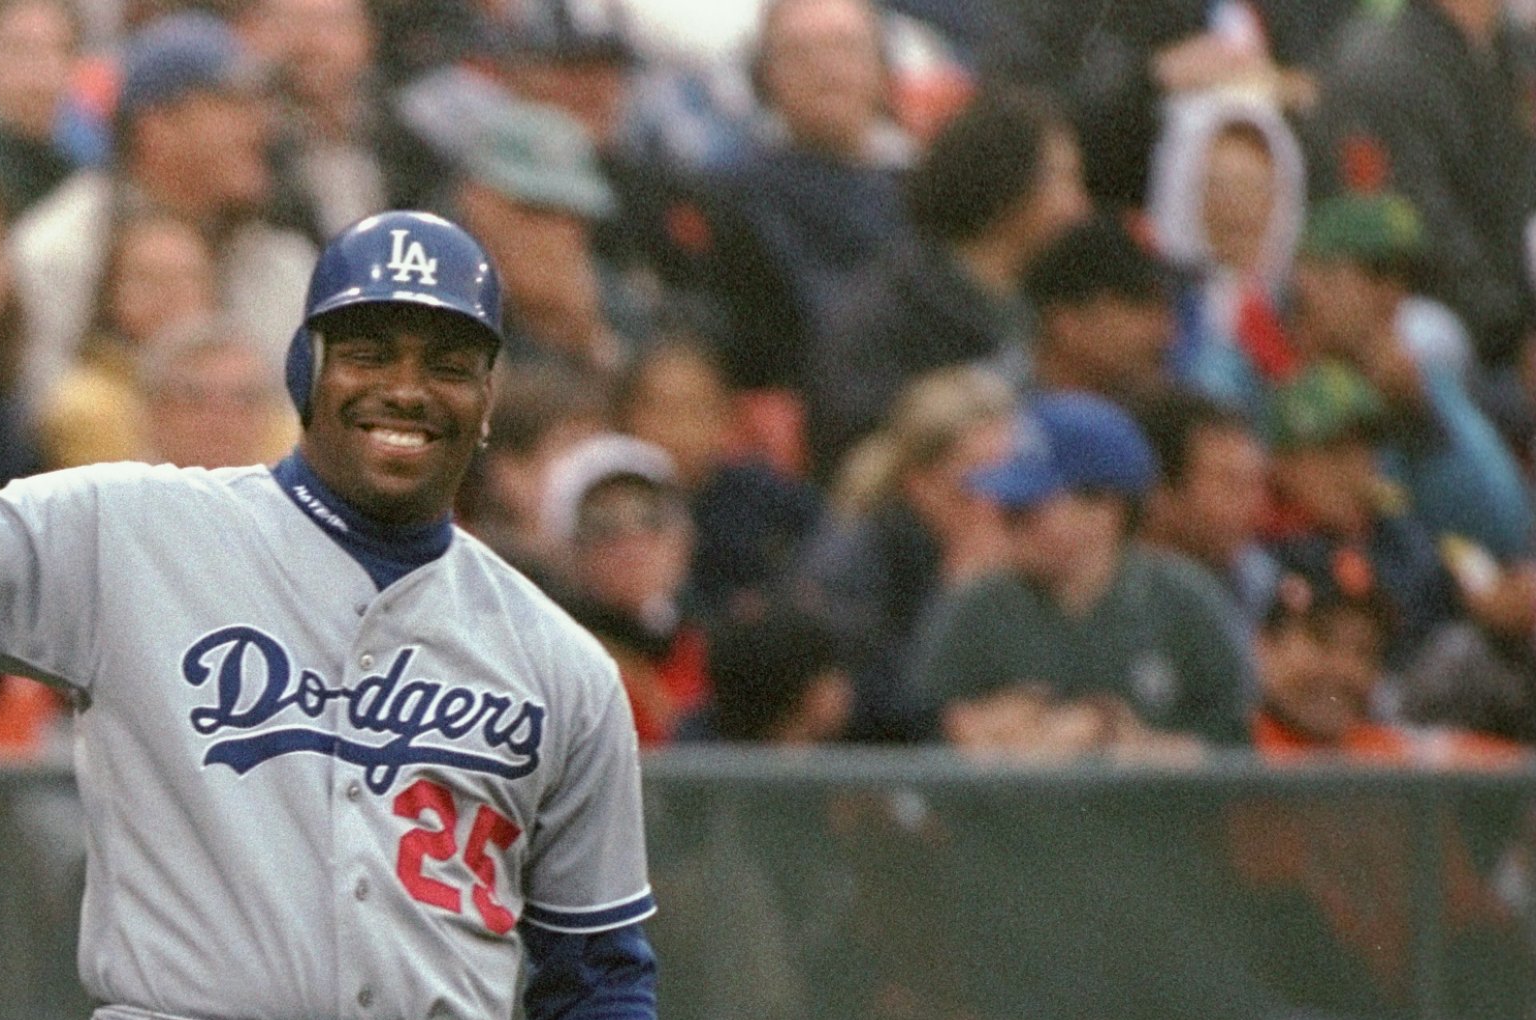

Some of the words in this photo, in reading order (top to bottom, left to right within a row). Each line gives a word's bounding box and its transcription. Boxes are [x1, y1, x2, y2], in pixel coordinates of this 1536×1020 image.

[386, 228, 438, 286] LA
[180, 623, 548, 797] Dodgers
[391, 777, 525, 937] 25
